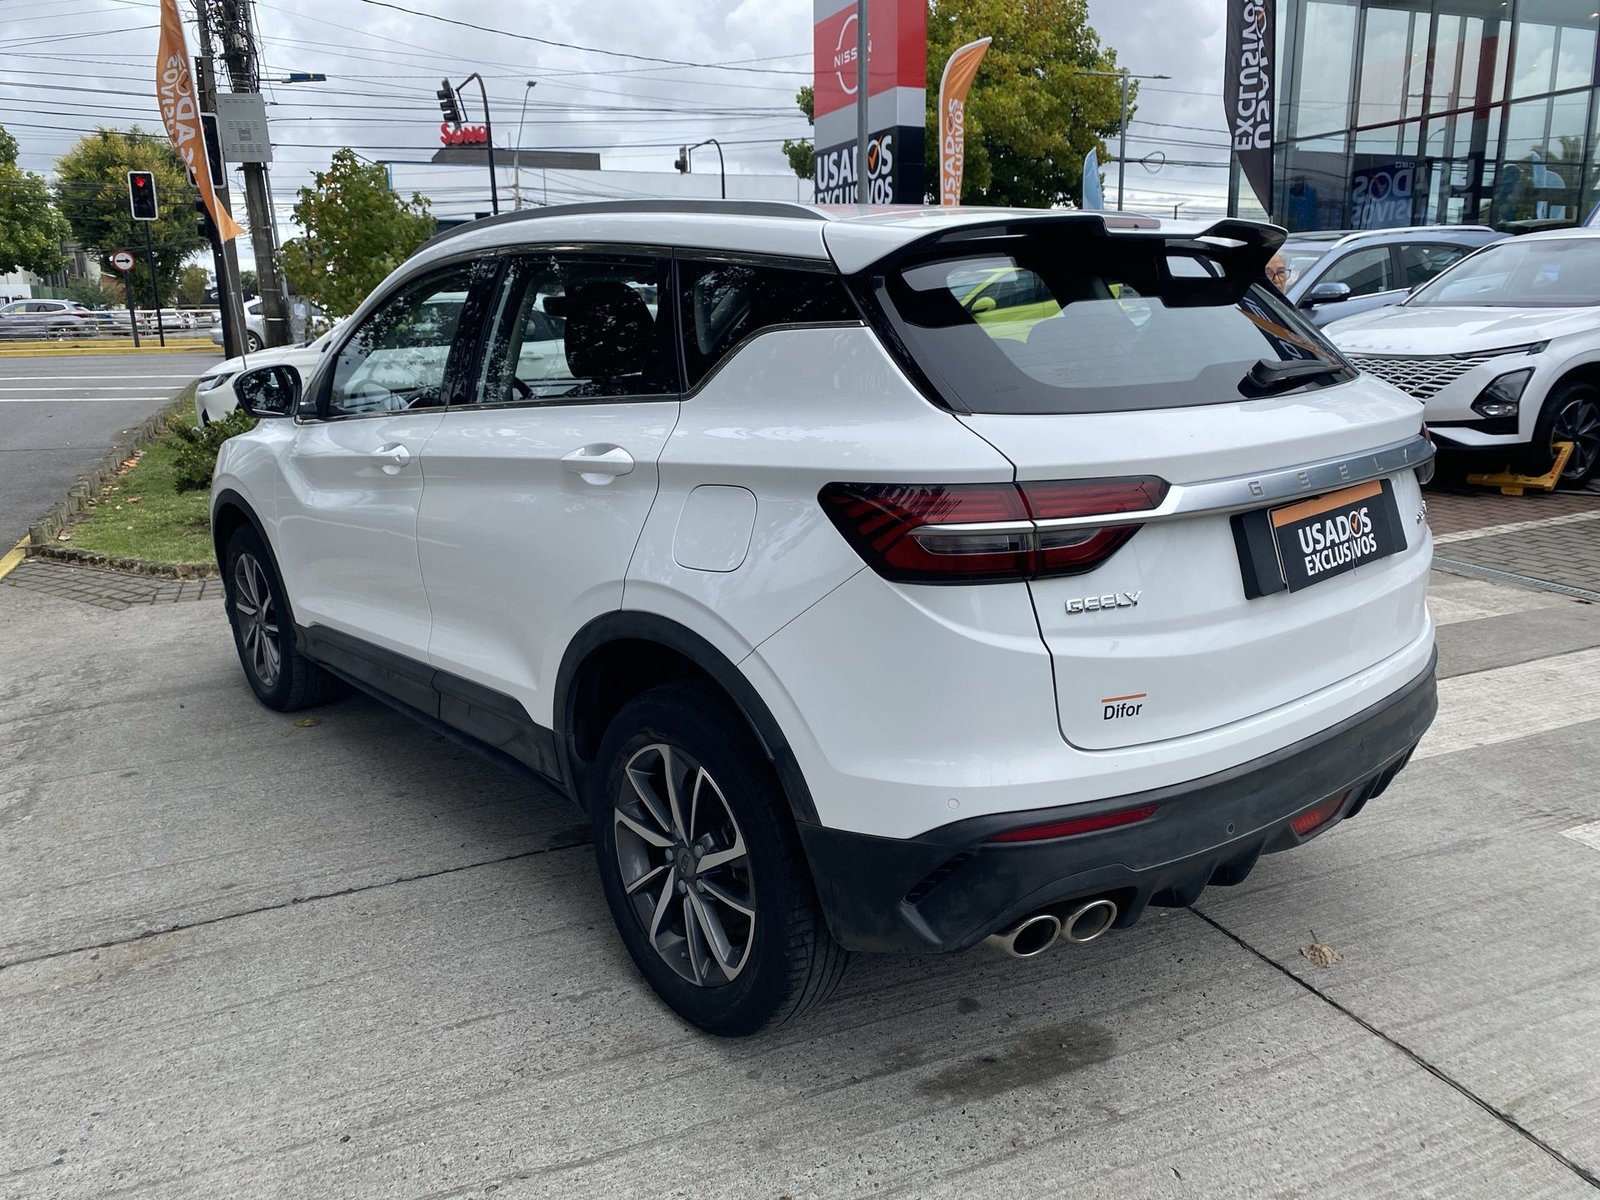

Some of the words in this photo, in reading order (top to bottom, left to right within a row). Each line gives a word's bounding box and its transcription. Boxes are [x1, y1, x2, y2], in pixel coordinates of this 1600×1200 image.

[834, 40, 872, 68] NISSN
[817, 176, 893, 205] EXCLUVOS
[1247, 448, 1409, 497] GEELY
[1298, 506, 1372, 554] USADOS
[1304, 533, 1377, 576] EXCLUSIVOS
[1065, 590, 1142, 615] GEELY
[1103, 703, 1143, 720] Difor
